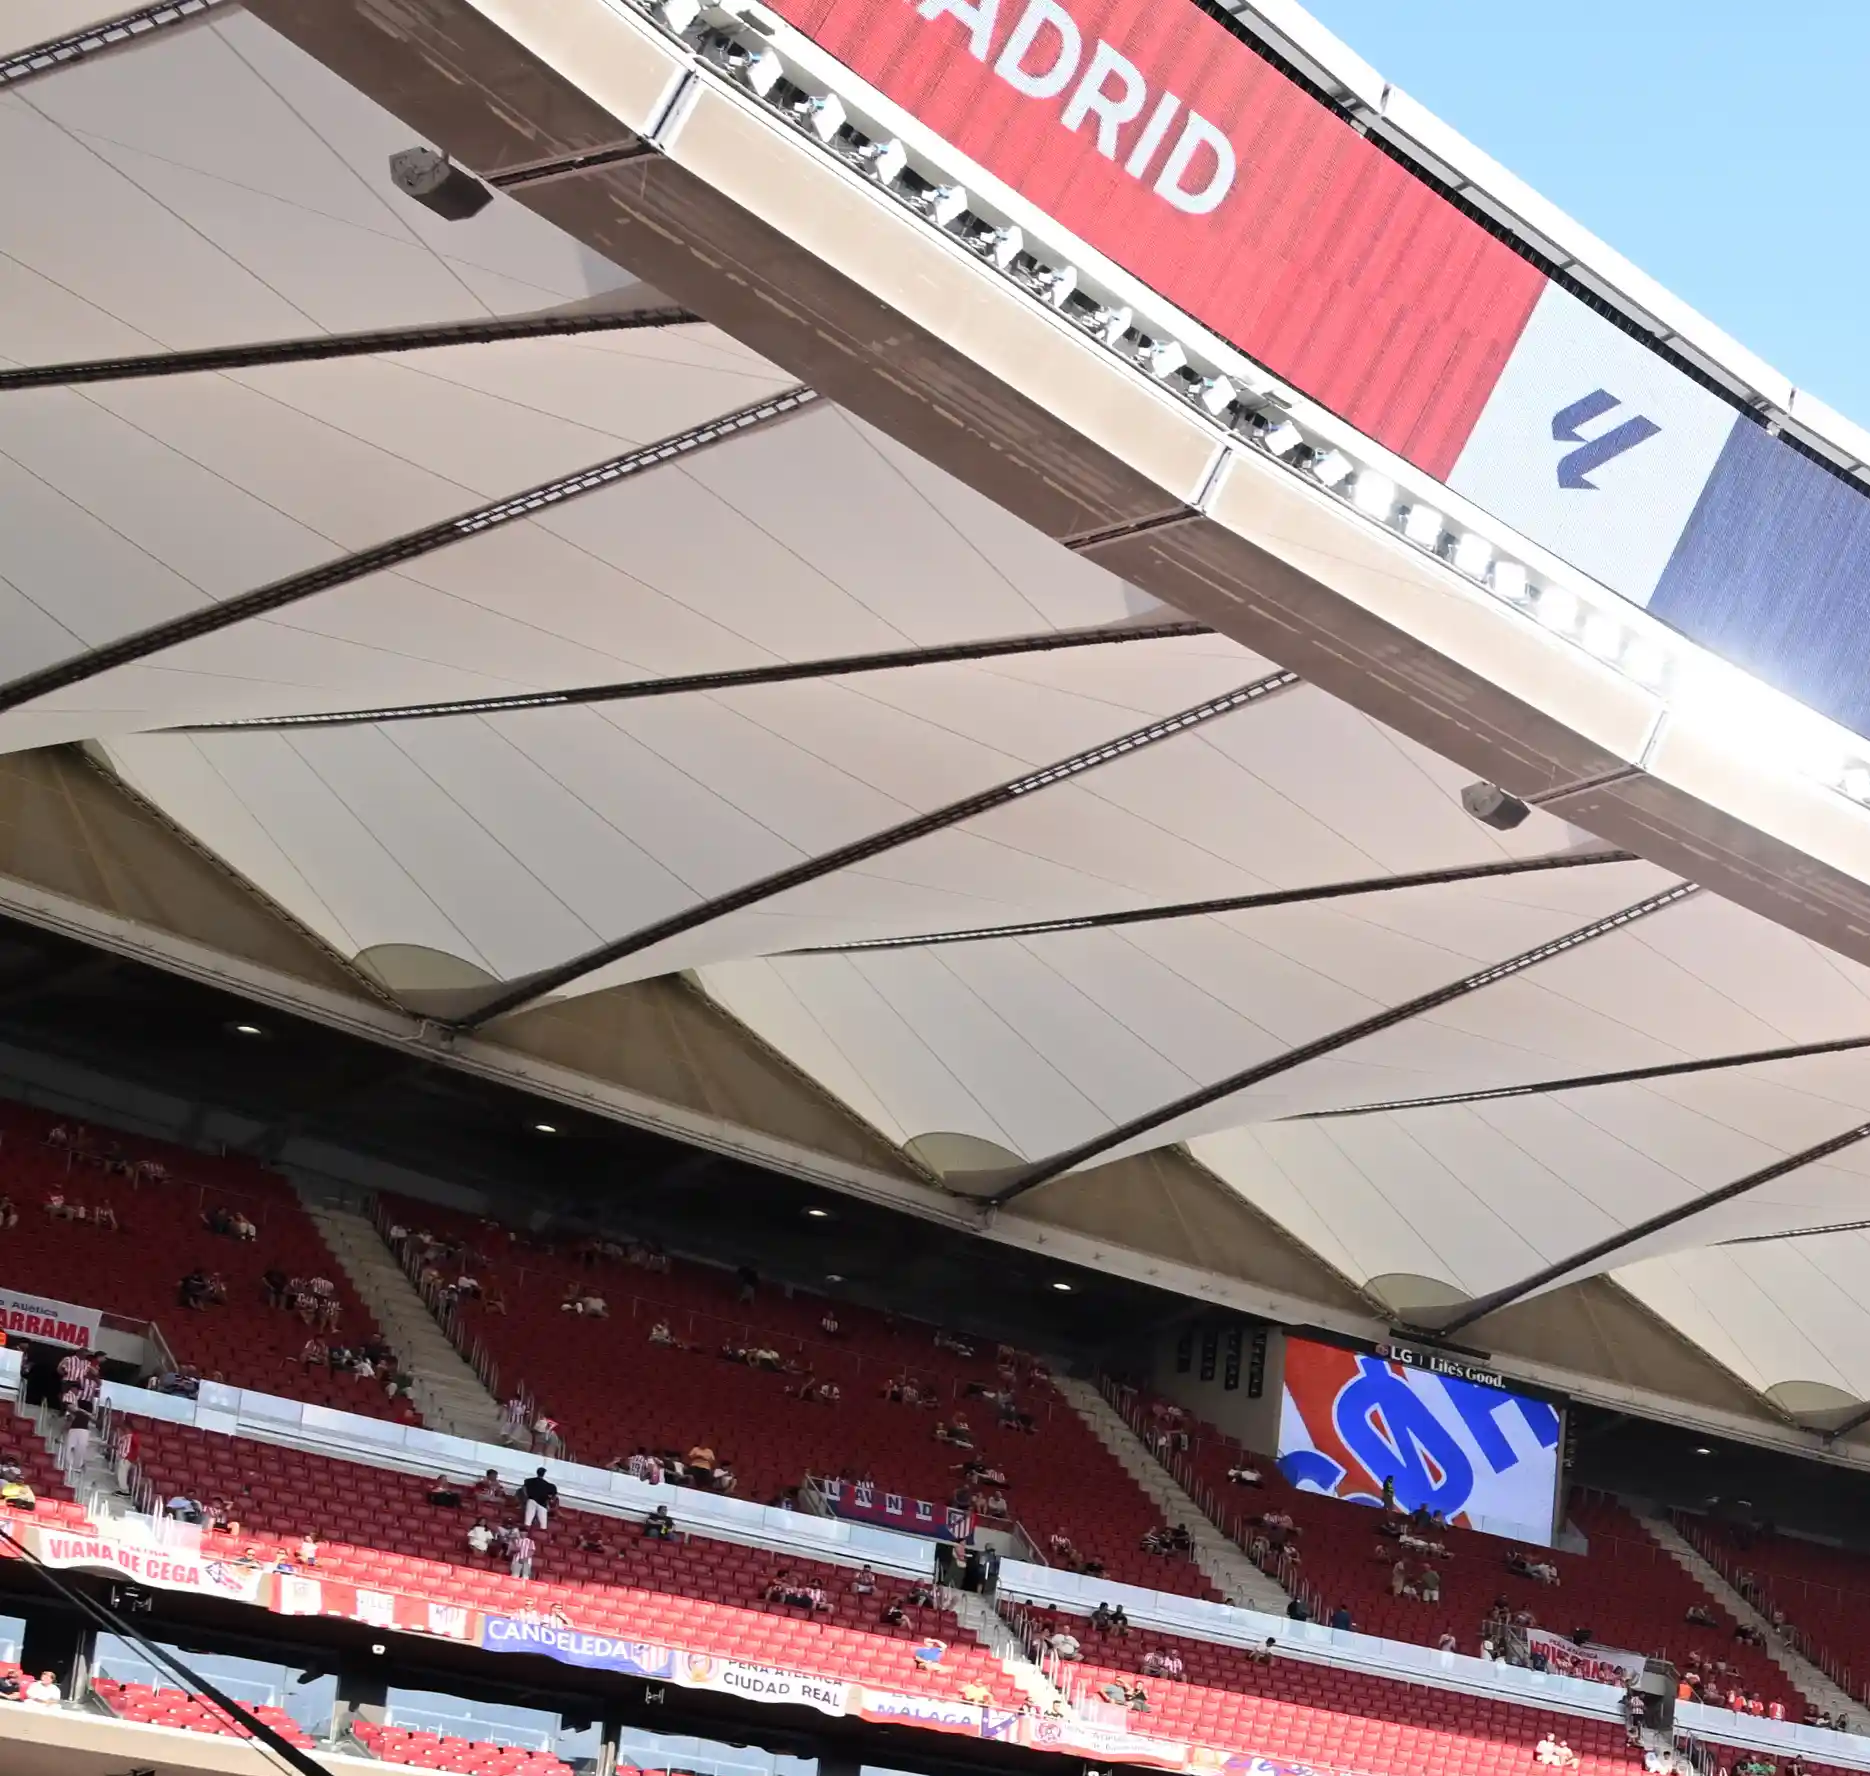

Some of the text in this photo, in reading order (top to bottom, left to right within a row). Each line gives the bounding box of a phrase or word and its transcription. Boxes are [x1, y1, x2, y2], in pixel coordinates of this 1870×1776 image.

[1391, 1345, 1506, 1388] LG Life's Good.
[49, 1538, 113, 1562] VIANA
[117, 1551, 138, 1574] DE
[146, 1559, 200, 1586] CEGA
[487, 1619, 628, 1661] CANDELEDA
[723, 1672, 840, 1707] CIUDAD REAL
